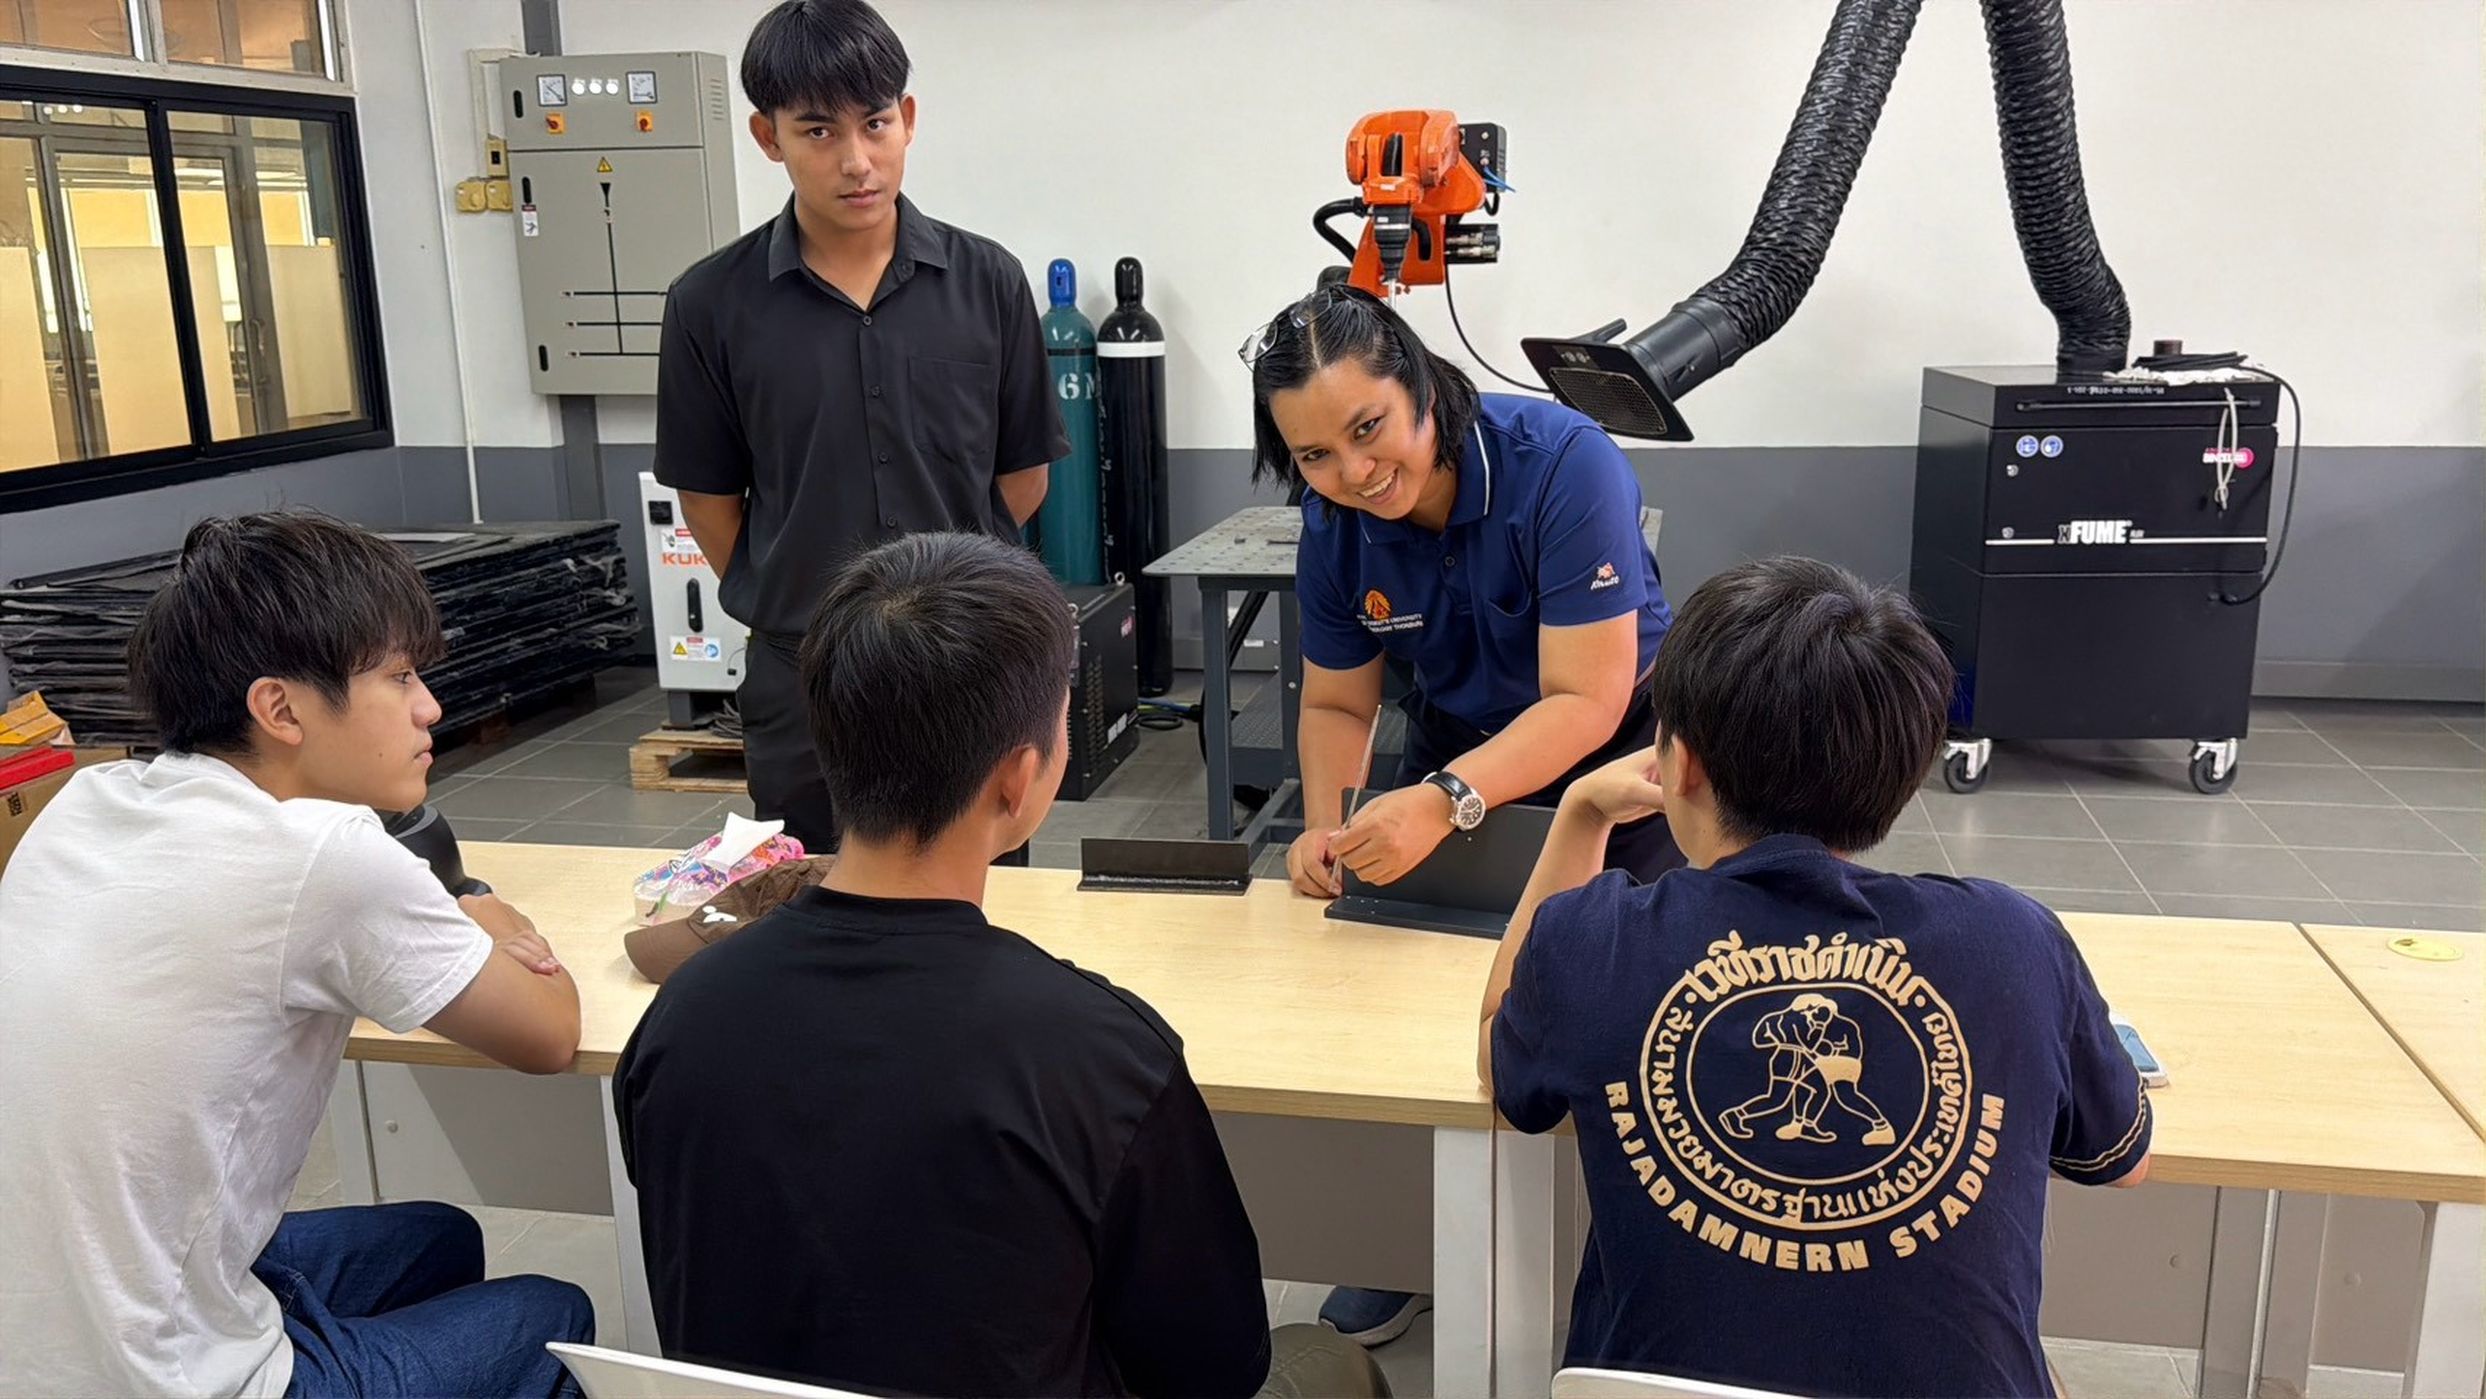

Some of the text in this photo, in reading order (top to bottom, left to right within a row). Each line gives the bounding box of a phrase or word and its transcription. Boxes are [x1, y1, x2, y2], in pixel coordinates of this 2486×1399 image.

[661, 551, 708, 566] KUK
[1605, 1081, 2006, 1272] RAJADAMNERN STADIUM
